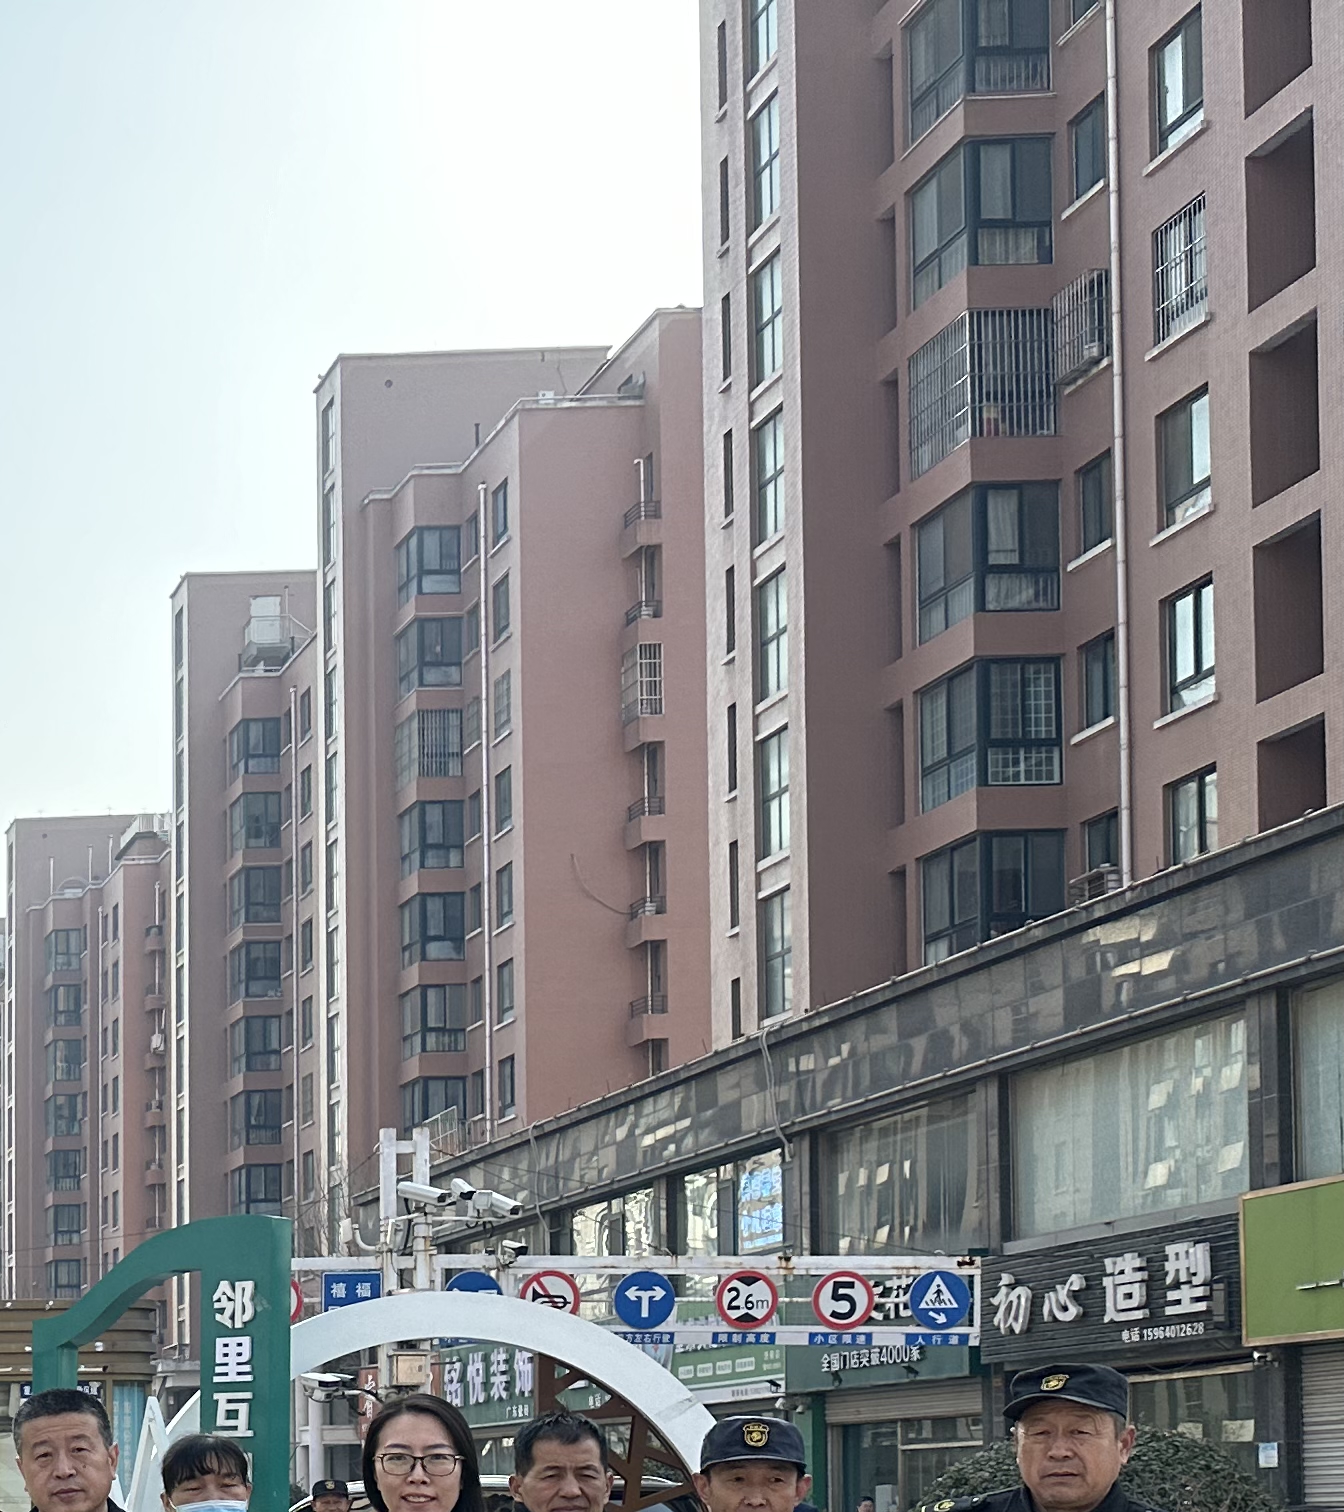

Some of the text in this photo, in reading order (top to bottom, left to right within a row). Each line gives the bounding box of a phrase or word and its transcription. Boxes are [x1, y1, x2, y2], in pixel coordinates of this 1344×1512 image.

[726, 1286, 769, 1311] 2.6m
[989, 1241, 1211, 1335] 初心造型
[829, 1281, 856, 1321] 5
[618, 1333, 670, 1343] 方左右行驶
[717, 1333, 770, 1343] 限制高度
[814, 1335, 866, 1345] 小区限速
[916, 1335, 959, 1345] 人行道
[1121, 1322, 1204, 1343] 电话 15964012628
[821, 1345, 921, 1372] 全国门店突破4000家
[212, 1280, 255, 1487] 邻里互
